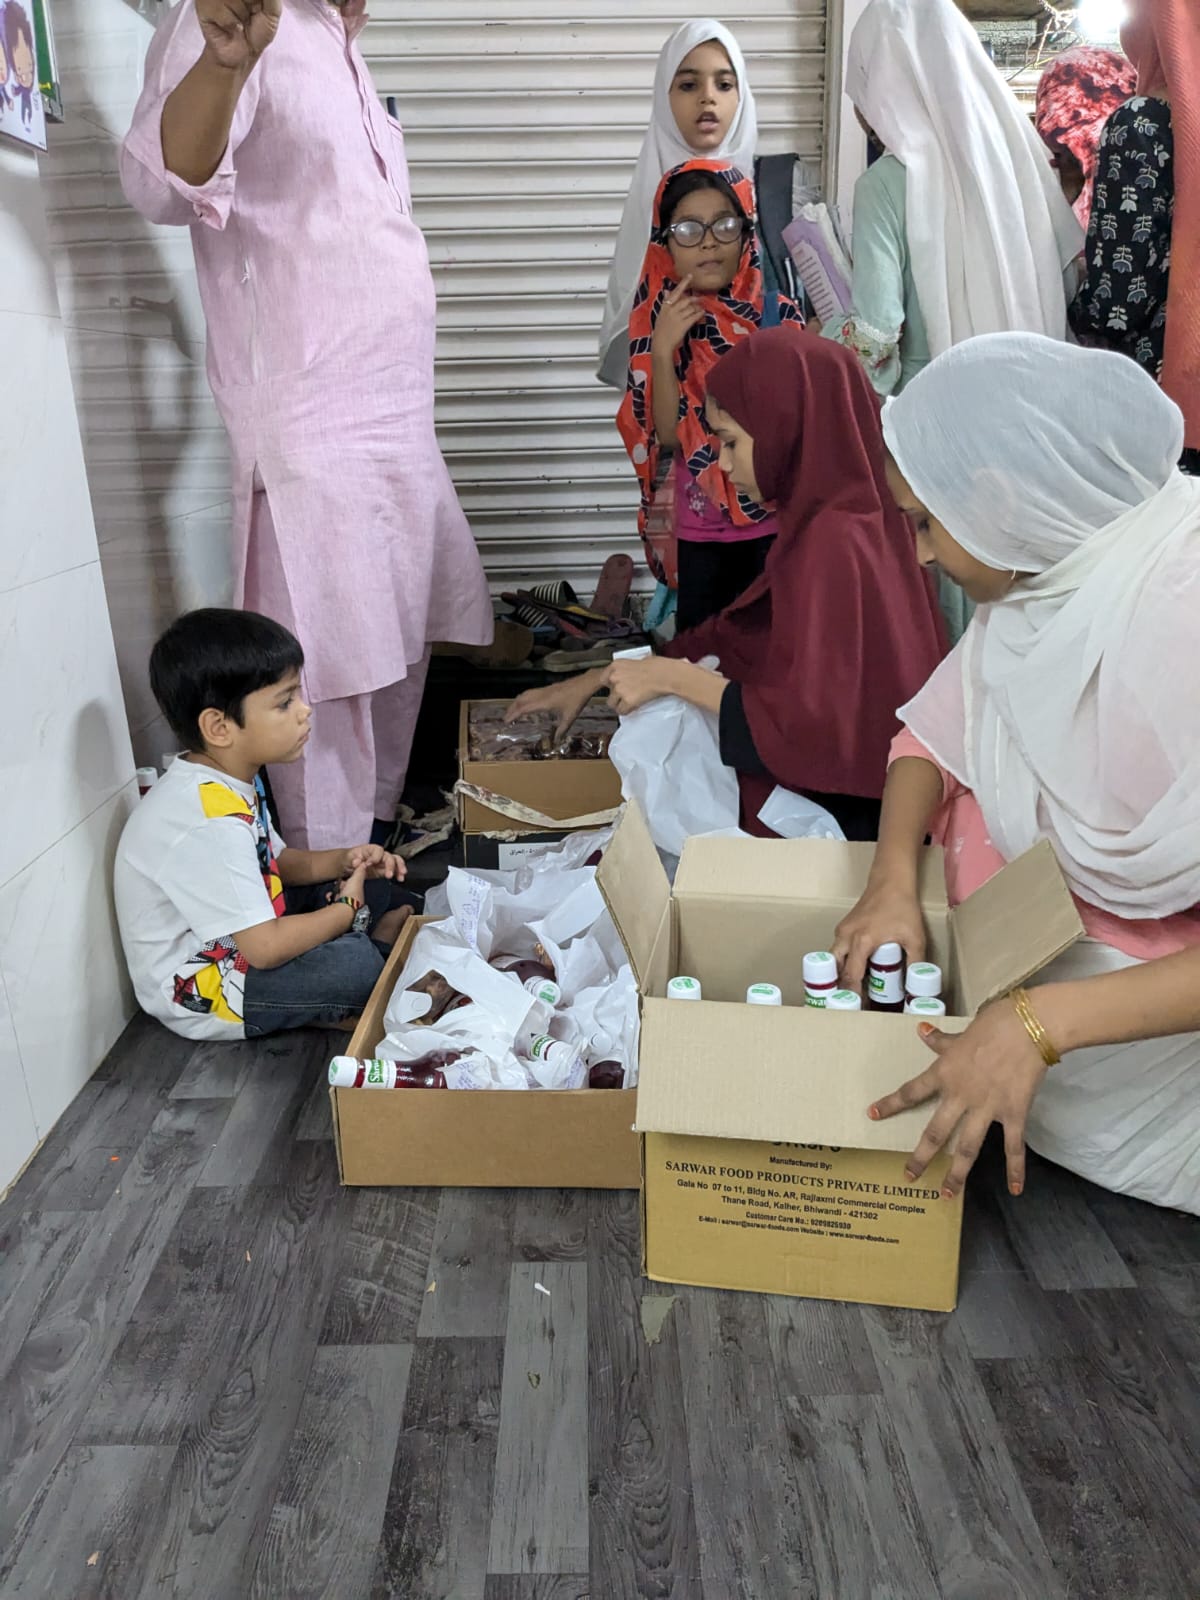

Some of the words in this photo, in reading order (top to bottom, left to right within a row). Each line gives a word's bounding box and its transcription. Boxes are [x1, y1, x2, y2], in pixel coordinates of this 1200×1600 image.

[769, 1157, 818, 1168] Manufactured
[820, 1162, 833, 1171] By:
[665, 1161, 717, 1176] SARWAR
[719, 1167, 754, 1180] FOOD
[757, 1172, 824, 1187] PRODUCTS
[827, 1179, 880, 1193] PRIVATE
[883, 1186, 940, 1200] LIMITED
[677, 1179, 695, 1189] Gala
[697, 1182, 708, 1190] No
[712, 1183, 721, 1191] 07
[747, 1187, 766, 1198] Bldg
[768, 1189, 781, 1198] No.
[783, 1191, 798, 1201] AR,
[837, 1197, 887, 1210] Commercial
[889, 1203, 926, 1215] Complex
[721, 1196, 747, 1206] Thane
[748, 1198, 772, 1209] Road,
[804, 1205, 842, 1217] Bhiwandi
[848, 1211, 879, 1221] 421302
[745, 1211, 777, 1222] Customer
[778, 1216, 794, 1224] Care
